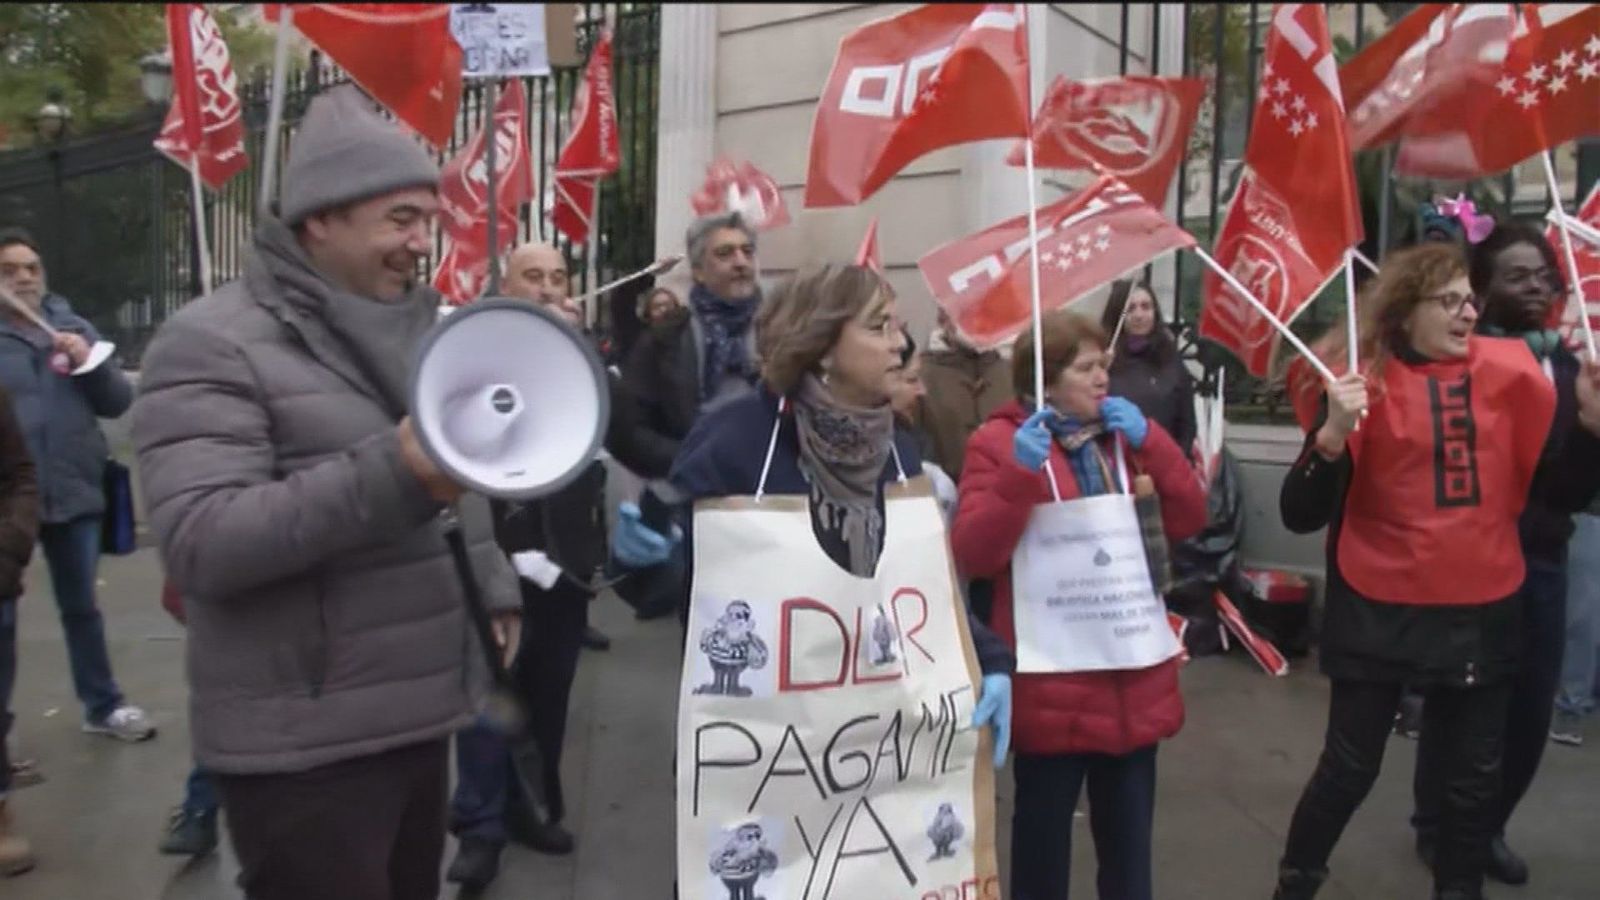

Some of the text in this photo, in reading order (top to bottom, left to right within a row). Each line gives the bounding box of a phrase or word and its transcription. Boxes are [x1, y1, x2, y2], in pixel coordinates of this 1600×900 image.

[779, 586, 935, 692] DLR
[693, 685, 971, 817] PAGAME
[794, 796, 918, 900] YA
